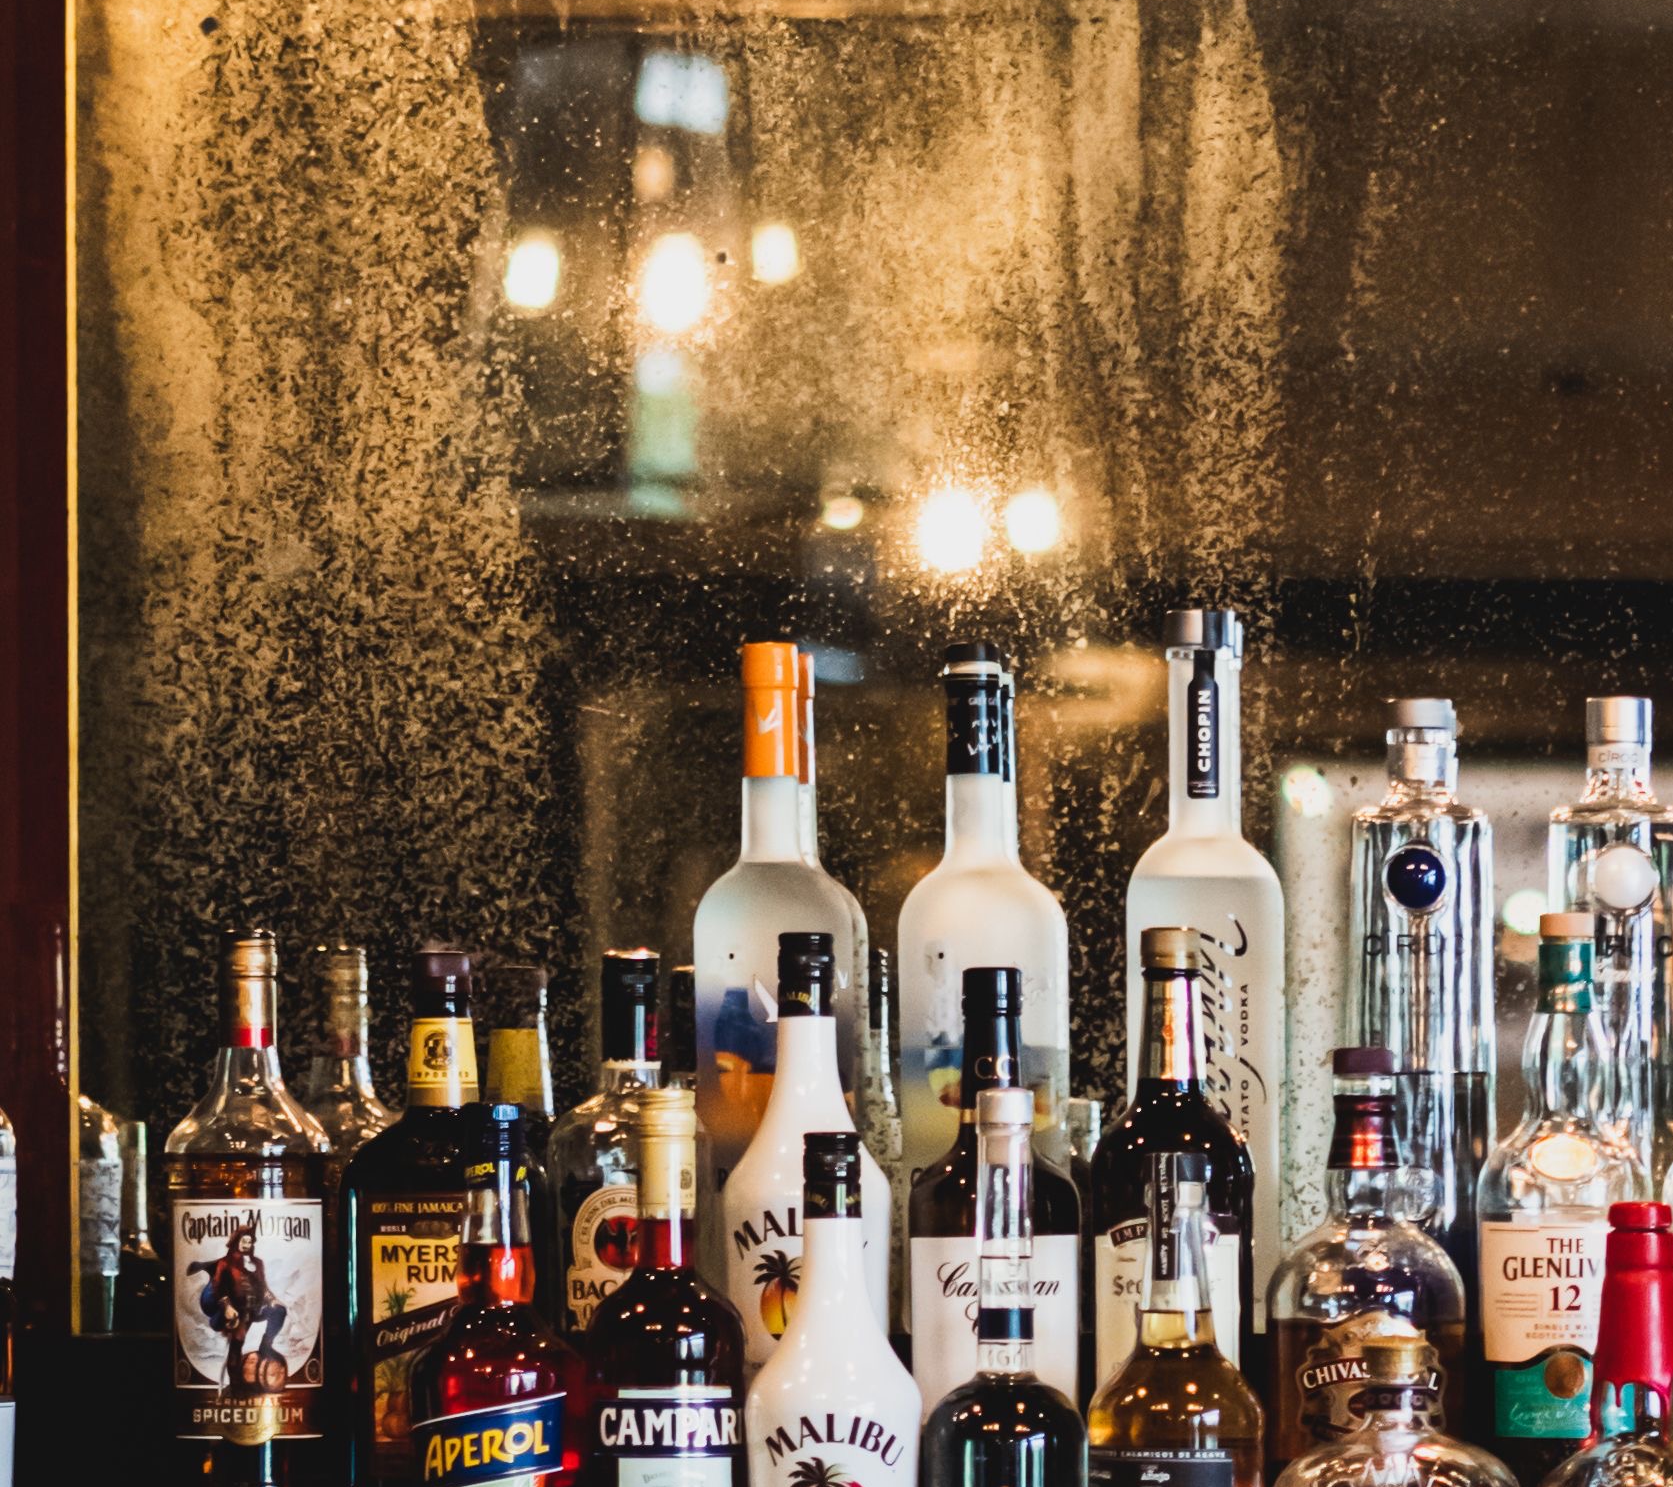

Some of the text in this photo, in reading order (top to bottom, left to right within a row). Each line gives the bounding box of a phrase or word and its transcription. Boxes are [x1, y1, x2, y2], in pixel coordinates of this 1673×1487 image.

[1197, 689, 1212, 773] CHOPIN
[1240, 983, 1249, 1047] VODKA
[181, 1208, 313, 1245] Captain Morgan
[1545, 1237, 1584, 1254] THE
[406, 1265, 459, 1283] RUM
[936, 1262, 1060, 1299] Caan
[1502, 1255, 1600, 1282] GLENLIV
[1549, 1284, 1582, 1312] 12
[376, 1310, 446, 1348] Original
[192, 1408, 257, 1424] SPICED
[424, 1419, 550, 1482] APEROL
[764, 1412, 905, 1468] MALIBU
